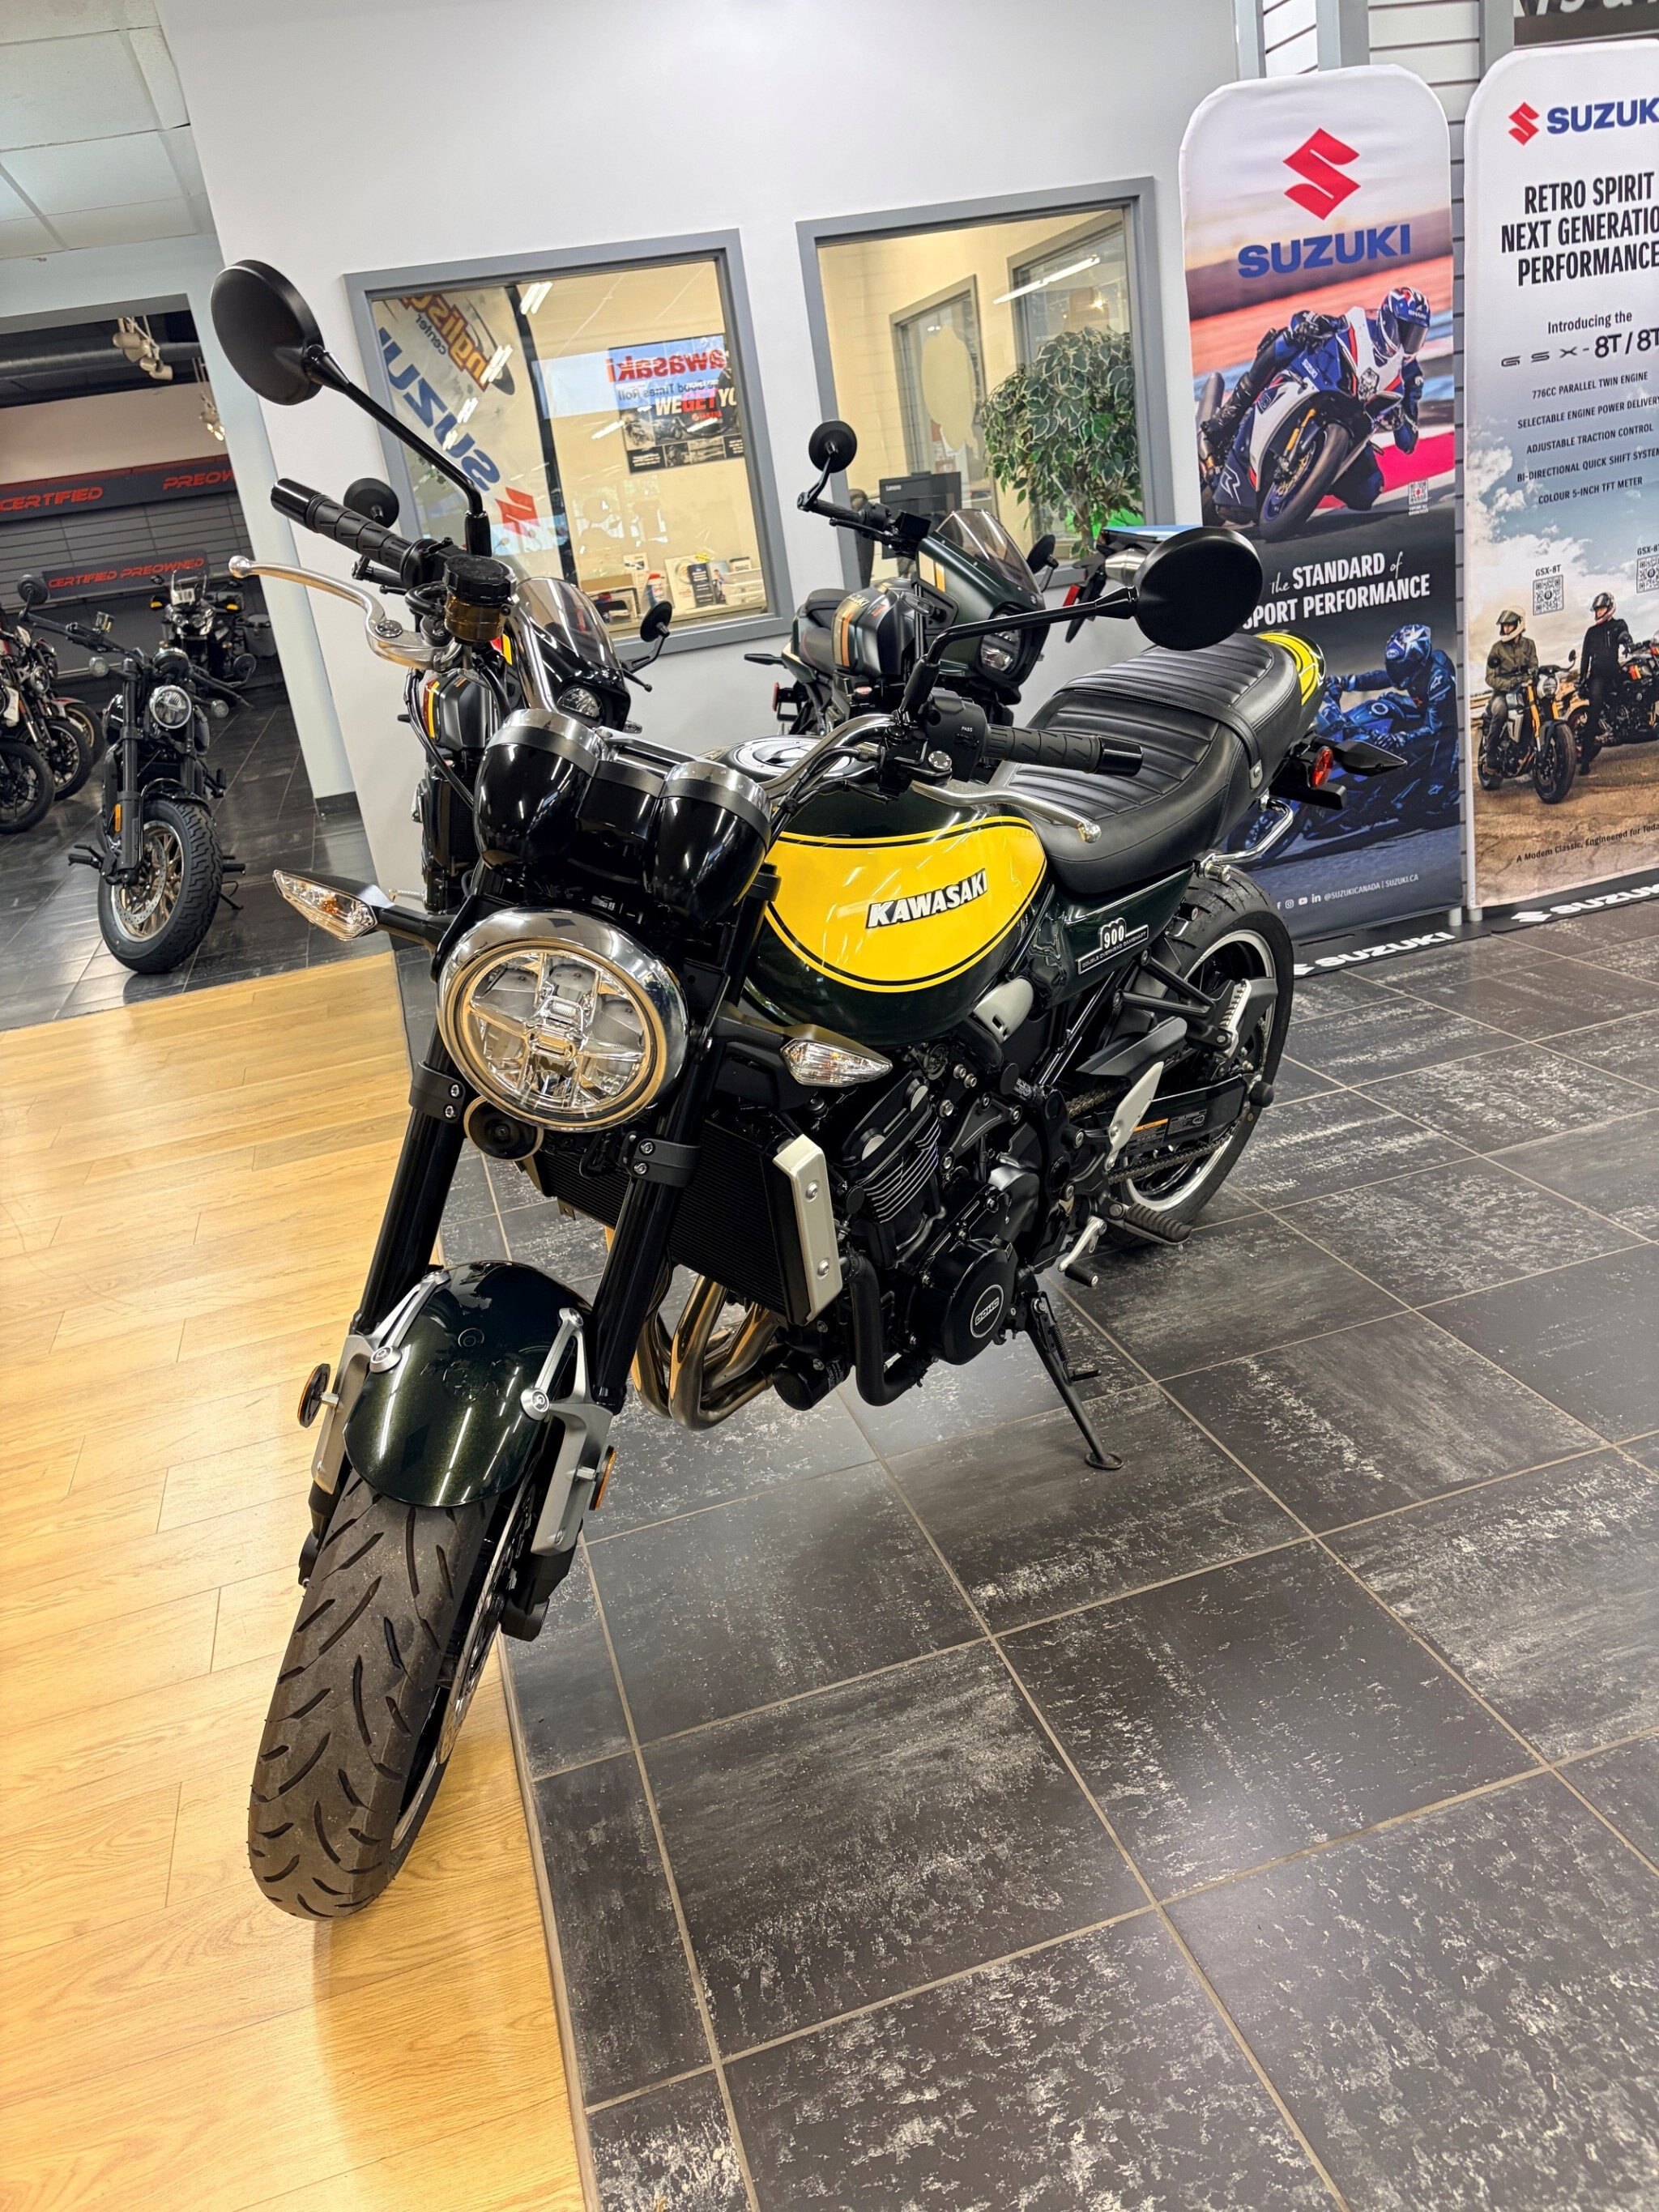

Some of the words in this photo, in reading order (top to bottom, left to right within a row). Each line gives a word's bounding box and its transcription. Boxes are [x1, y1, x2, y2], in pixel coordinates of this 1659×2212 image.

[1546, 97, 1659, 134] SUZUK
[1525, 180, 1586, 215] RETRO
[1593, 172, 1655, 206] SPIRIT
[1501, 219, 1551, 253] NEXT
[1558, 205, 1659, 246] GENERATIO
[1238, 224, 1410, 278] SUZUKI
[1518, 241, 1659, 287] PERFORMANCE
[1548, 314, 1611, 334] Introducing
[1615, 311, 1632, 323] the
[1532, 387, 1556, 399] 776CC
[1559, 380, 1597, 395] PARALLEL
[1599, 377, 1618, 387] TWIN
[1620, 371, 1648, 384] ENGINE
[1517, 412, 1565, 429] SELECTABLE
[1567, 407, 1596, 420] ENGINE
[1597, 402, 1625, 415] POWER
[1526, 437, 1576, 454] ADJUSTABLE
[1578, 429, 1616, 445] TRACTION
[1618, 423, 1653, 437] CONTROL
[1517, 462, 1580, 482] BI-DIRECTIONAL
[1583, 458, 1606, 471] QUICK
[1609, 453, 1631, 465] SHIFT
[0, 486, 104, 511] CERTIFIED
[1538, 491, 1570, 505] COLOUR
[1572, 484, 1600, 498] 5-INCH
[1601, 482, 1615, 492] TFT
[1618, 476, 1643, 488] METER
[1637, 543, 1659, 556] GSX-8
[49, 570, 117, 589] CERTIFIED
[121, 557, 204, 578] PREOWNED
[1292, 552, 1385, 590] STANDARD
[1390, 551, 1403, 579] of
[1536, 565, 1561, 577] GSX-8T
[1303, 574, 1431, 618] PERFORMANCE
[1516, 855, 1523, 863] A
[1585, 830, 1628, 846] Engineered
[1630, 828, 1641, 837] for
[867, 868, 988, 928] KAWASAKI
[1324, 883, 1380, 901] @SUZUKICANADA
[1385, 874, 1419, 888] SUZUKI.CA
[1104, 925, 1124, 948] 900
[1315, 931, 1456, 967] SUZUKI
[976, 1299, 999, 1323] DOHC
